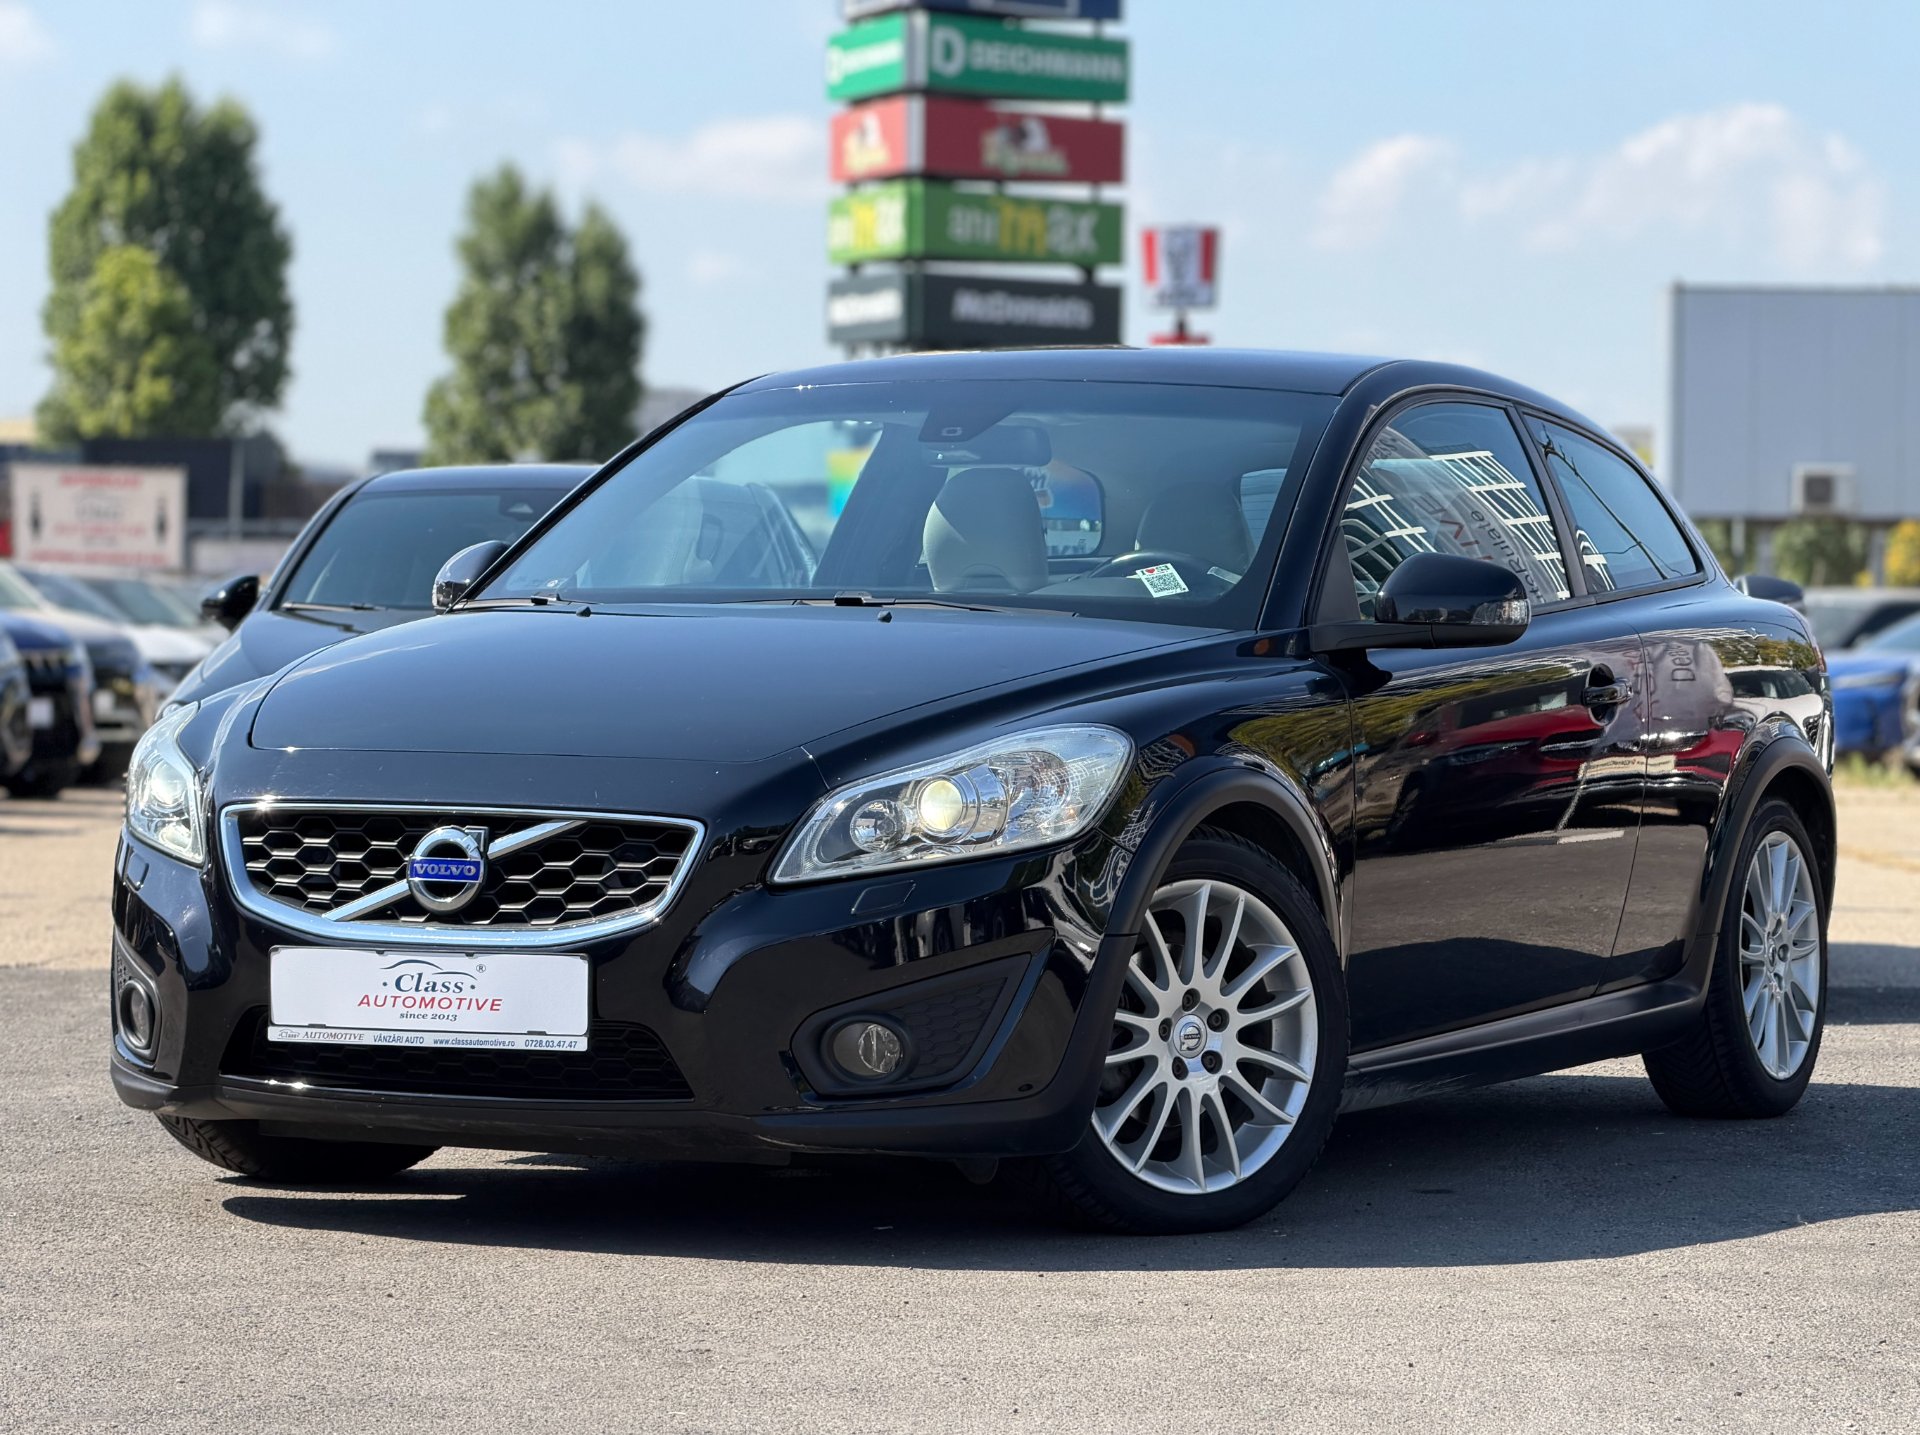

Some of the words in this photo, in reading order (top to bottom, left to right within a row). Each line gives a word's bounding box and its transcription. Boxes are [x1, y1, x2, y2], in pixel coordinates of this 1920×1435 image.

[414, 863, 477, 877] VOLVO
[395, 972, 464, 994] Class
[358, 994, 503, 1012] AUTOMOTIVE
[399, 1010, 428, 1020] since
[431, 1012, 458, 1022] 2013
[303, 1031, 364, 1041] AUTOMOTIVE
[405, 1035, 425, 1045] AUTO
[433, 1037, 516, 1047] www.classautomotive.ro
[524, 1039, 578, 1049] 0728.03.47.47
